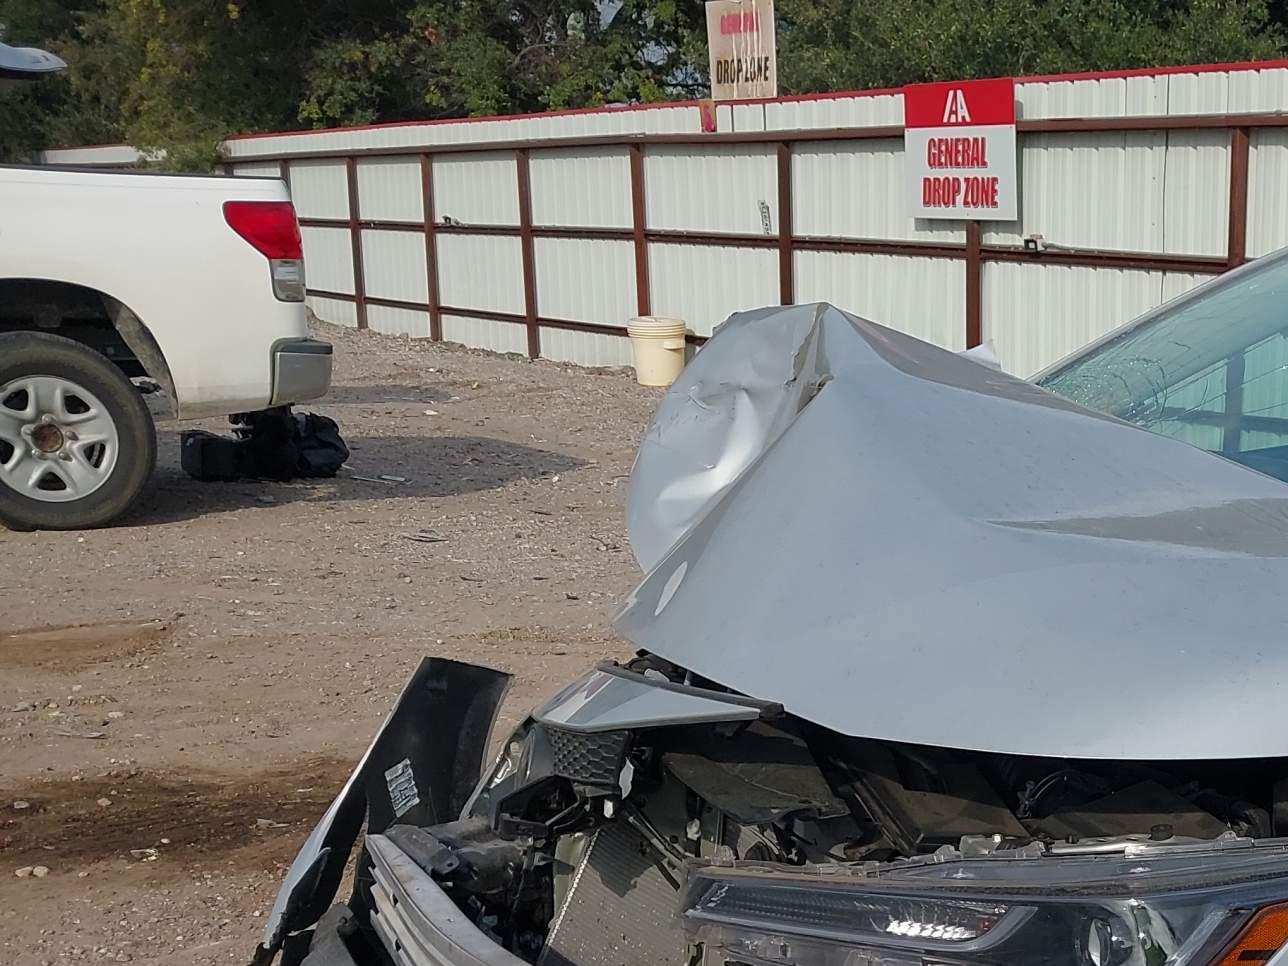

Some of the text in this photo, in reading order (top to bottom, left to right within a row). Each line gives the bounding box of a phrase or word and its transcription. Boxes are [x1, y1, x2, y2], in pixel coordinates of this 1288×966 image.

[716, 58, 743, 84] DROP
[927, 137, 988, 168] GENERAL
[922, 176, 999, 209] DROP ZONE
